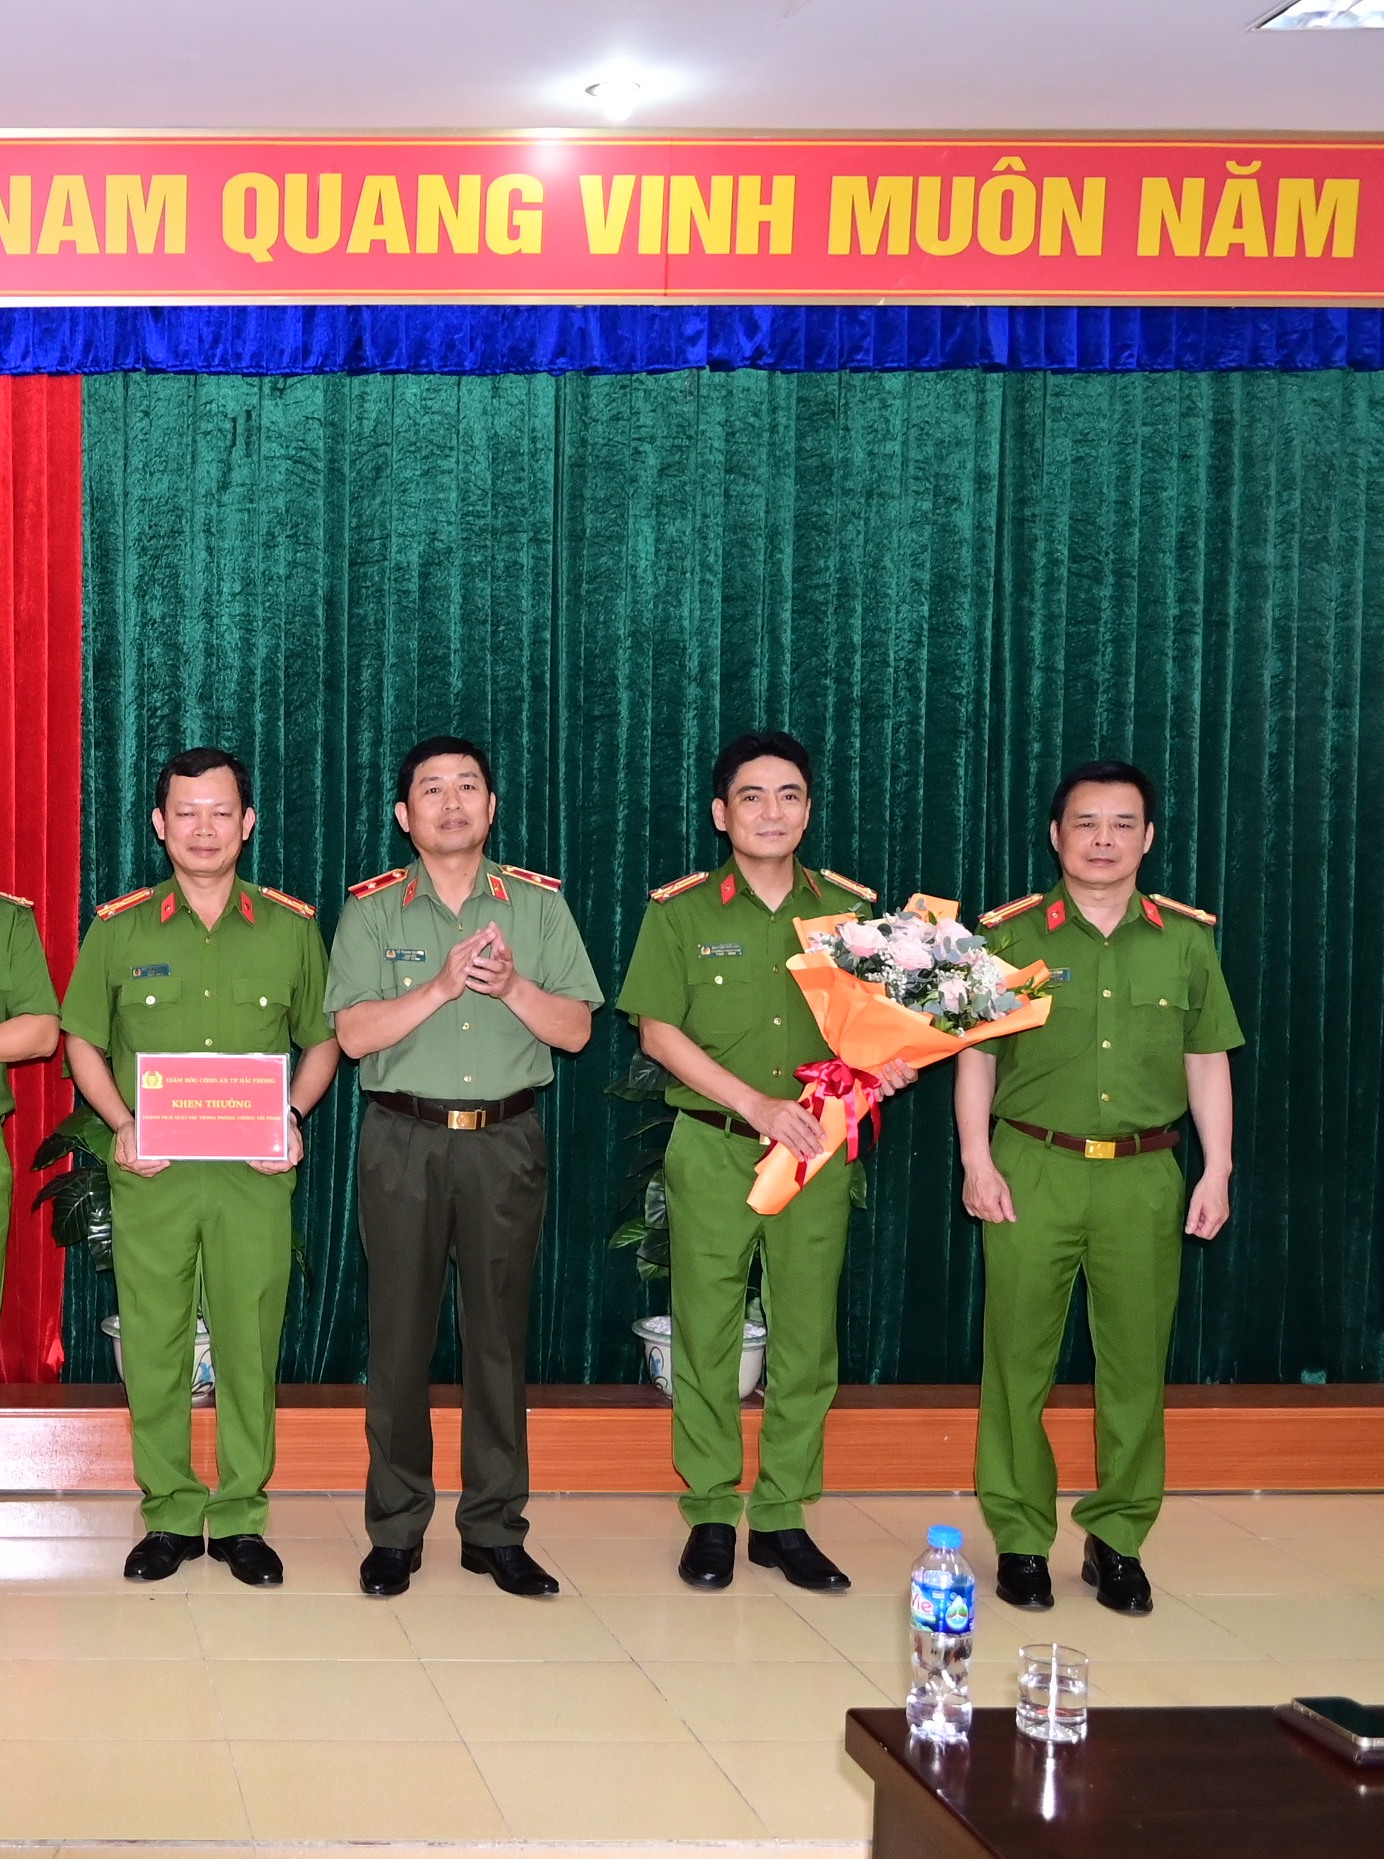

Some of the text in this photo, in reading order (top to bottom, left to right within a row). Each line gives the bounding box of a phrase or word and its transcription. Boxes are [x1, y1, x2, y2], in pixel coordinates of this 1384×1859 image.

[222, 173, 545, 262] QUANG
[580, 174, 796, 255] VINH
[828, 157, 1107, 256] MUÔN
[1137, 161, 1360, 258] NĂM
[172, 1099, 203, 1108] KHEN
